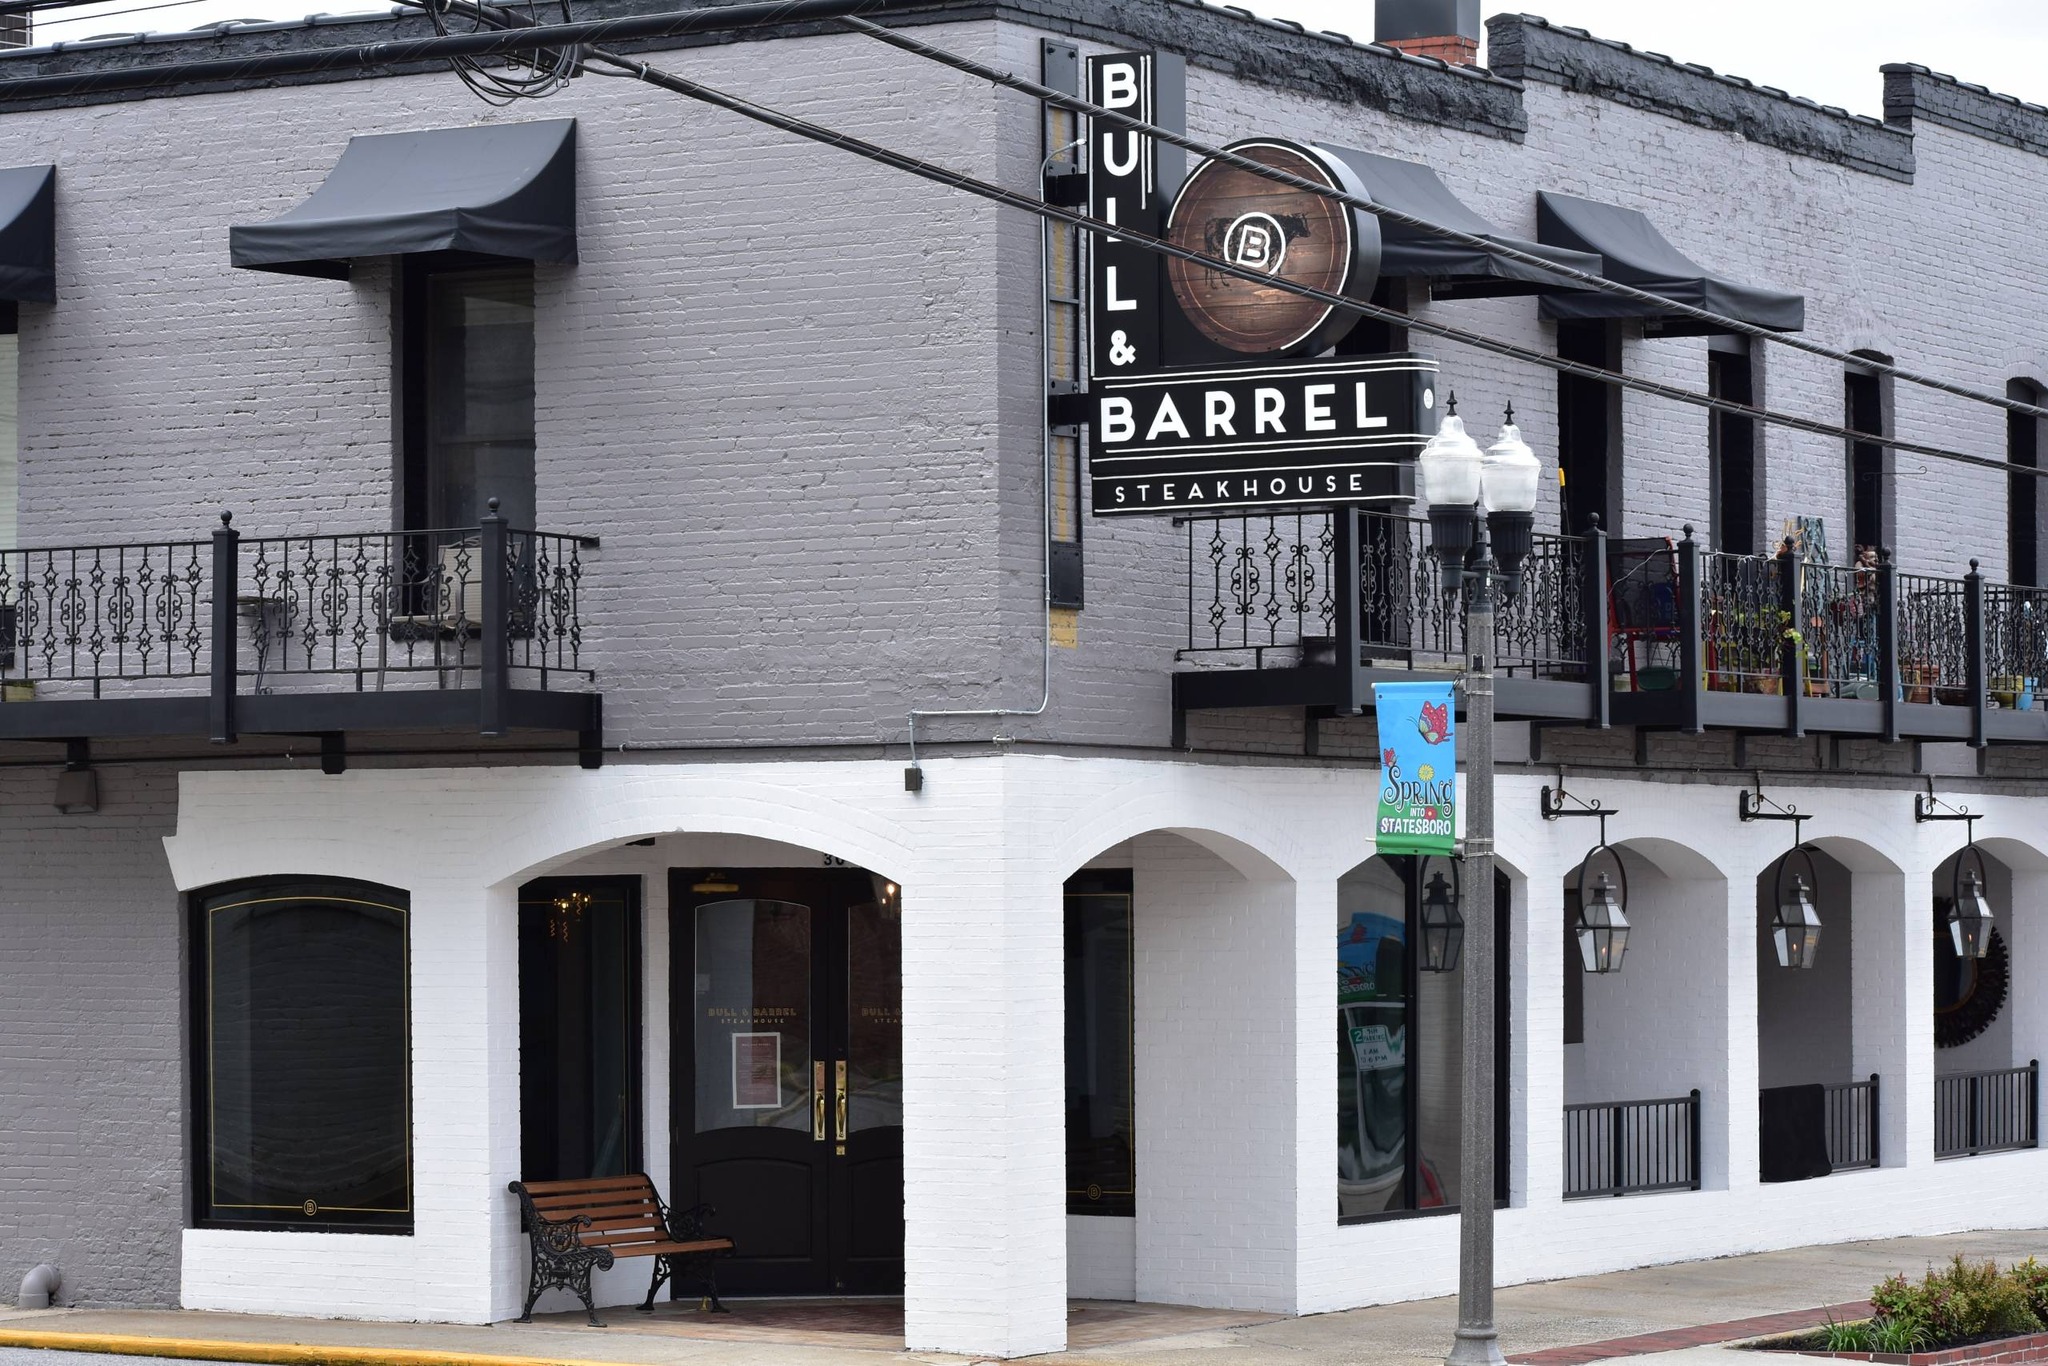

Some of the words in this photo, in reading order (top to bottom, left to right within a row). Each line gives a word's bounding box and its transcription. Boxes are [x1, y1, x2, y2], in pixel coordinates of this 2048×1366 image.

[1109, 330, 1136, 366] &
[1100, 381, 1388, 443] BARREL
[1115, 473, 1362, 503] STEAKHOUSE
[1410, 807, 1425, 817] INTO
[1380, 818, 1451, 835] STATESBORO
[708, 1008, 737, 1017] BULL
[753, 1007, 797, 1016] BARREL
[1354, 1030, 1363, 1042] 2
